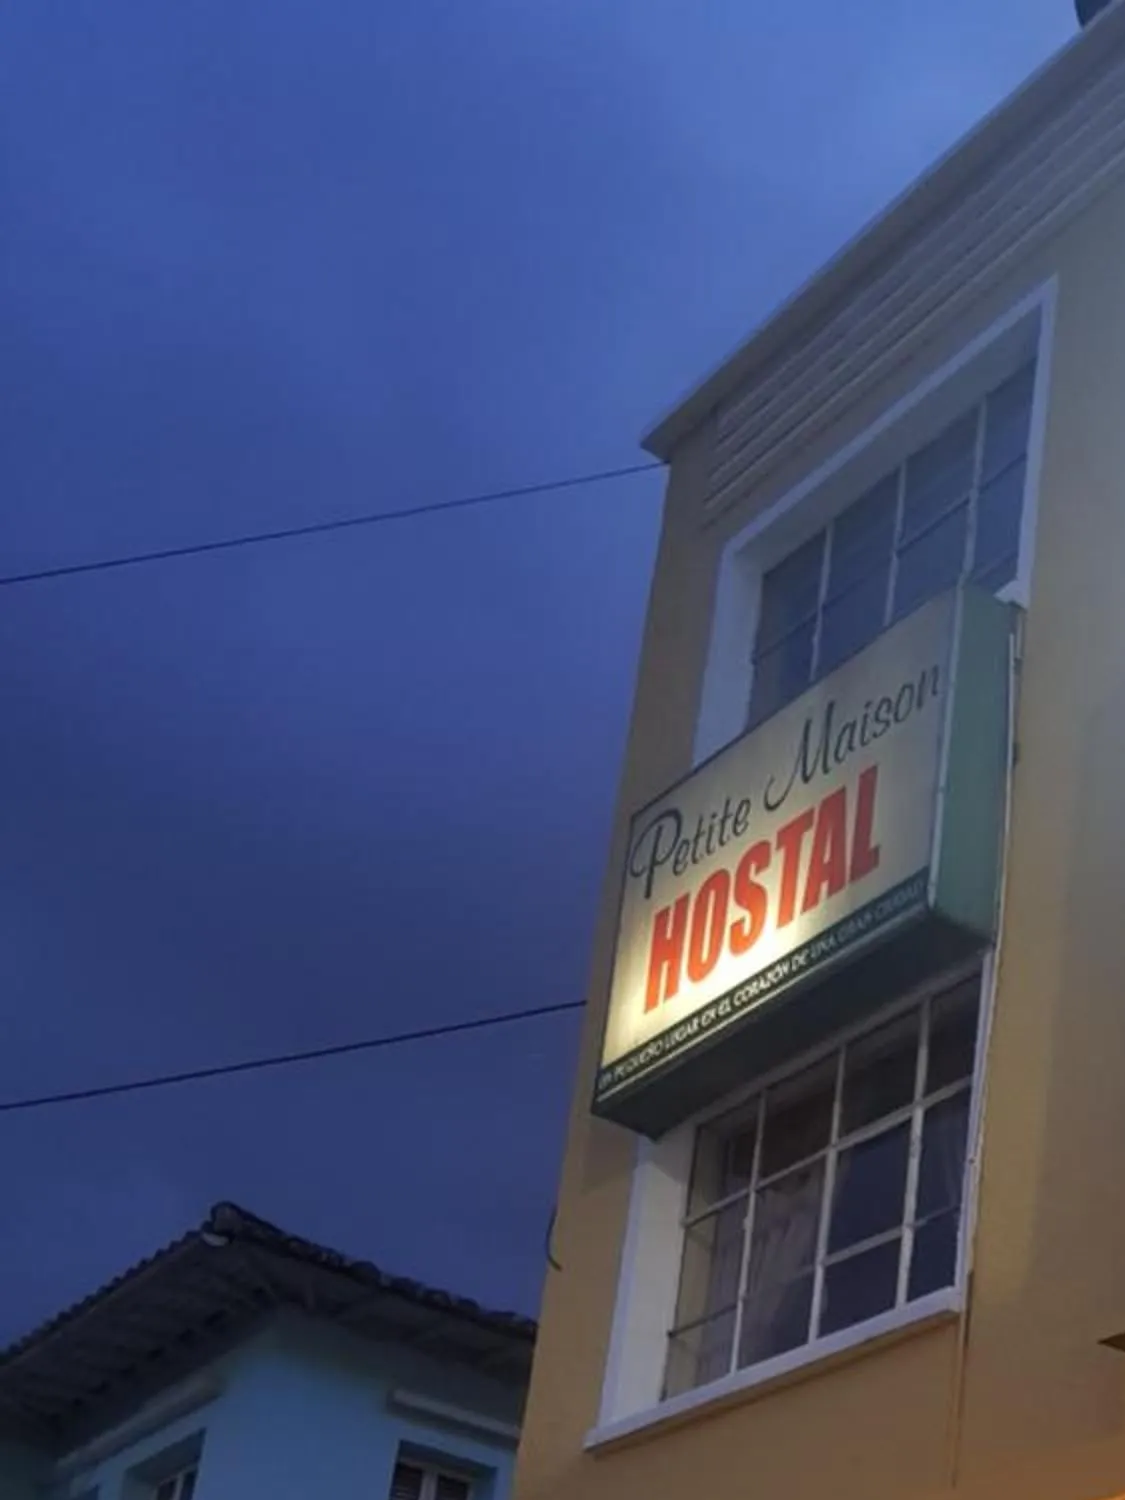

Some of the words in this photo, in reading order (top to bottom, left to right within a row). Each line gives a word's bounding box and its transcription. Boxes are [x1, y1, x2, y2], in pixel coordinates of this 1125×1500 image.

[628, 792, 751, 899] Petite
[763, 663, 941, 809] Maison
[643, 764, 880, 1015] HOSTAL
[791, 949, 809, 971] DE
